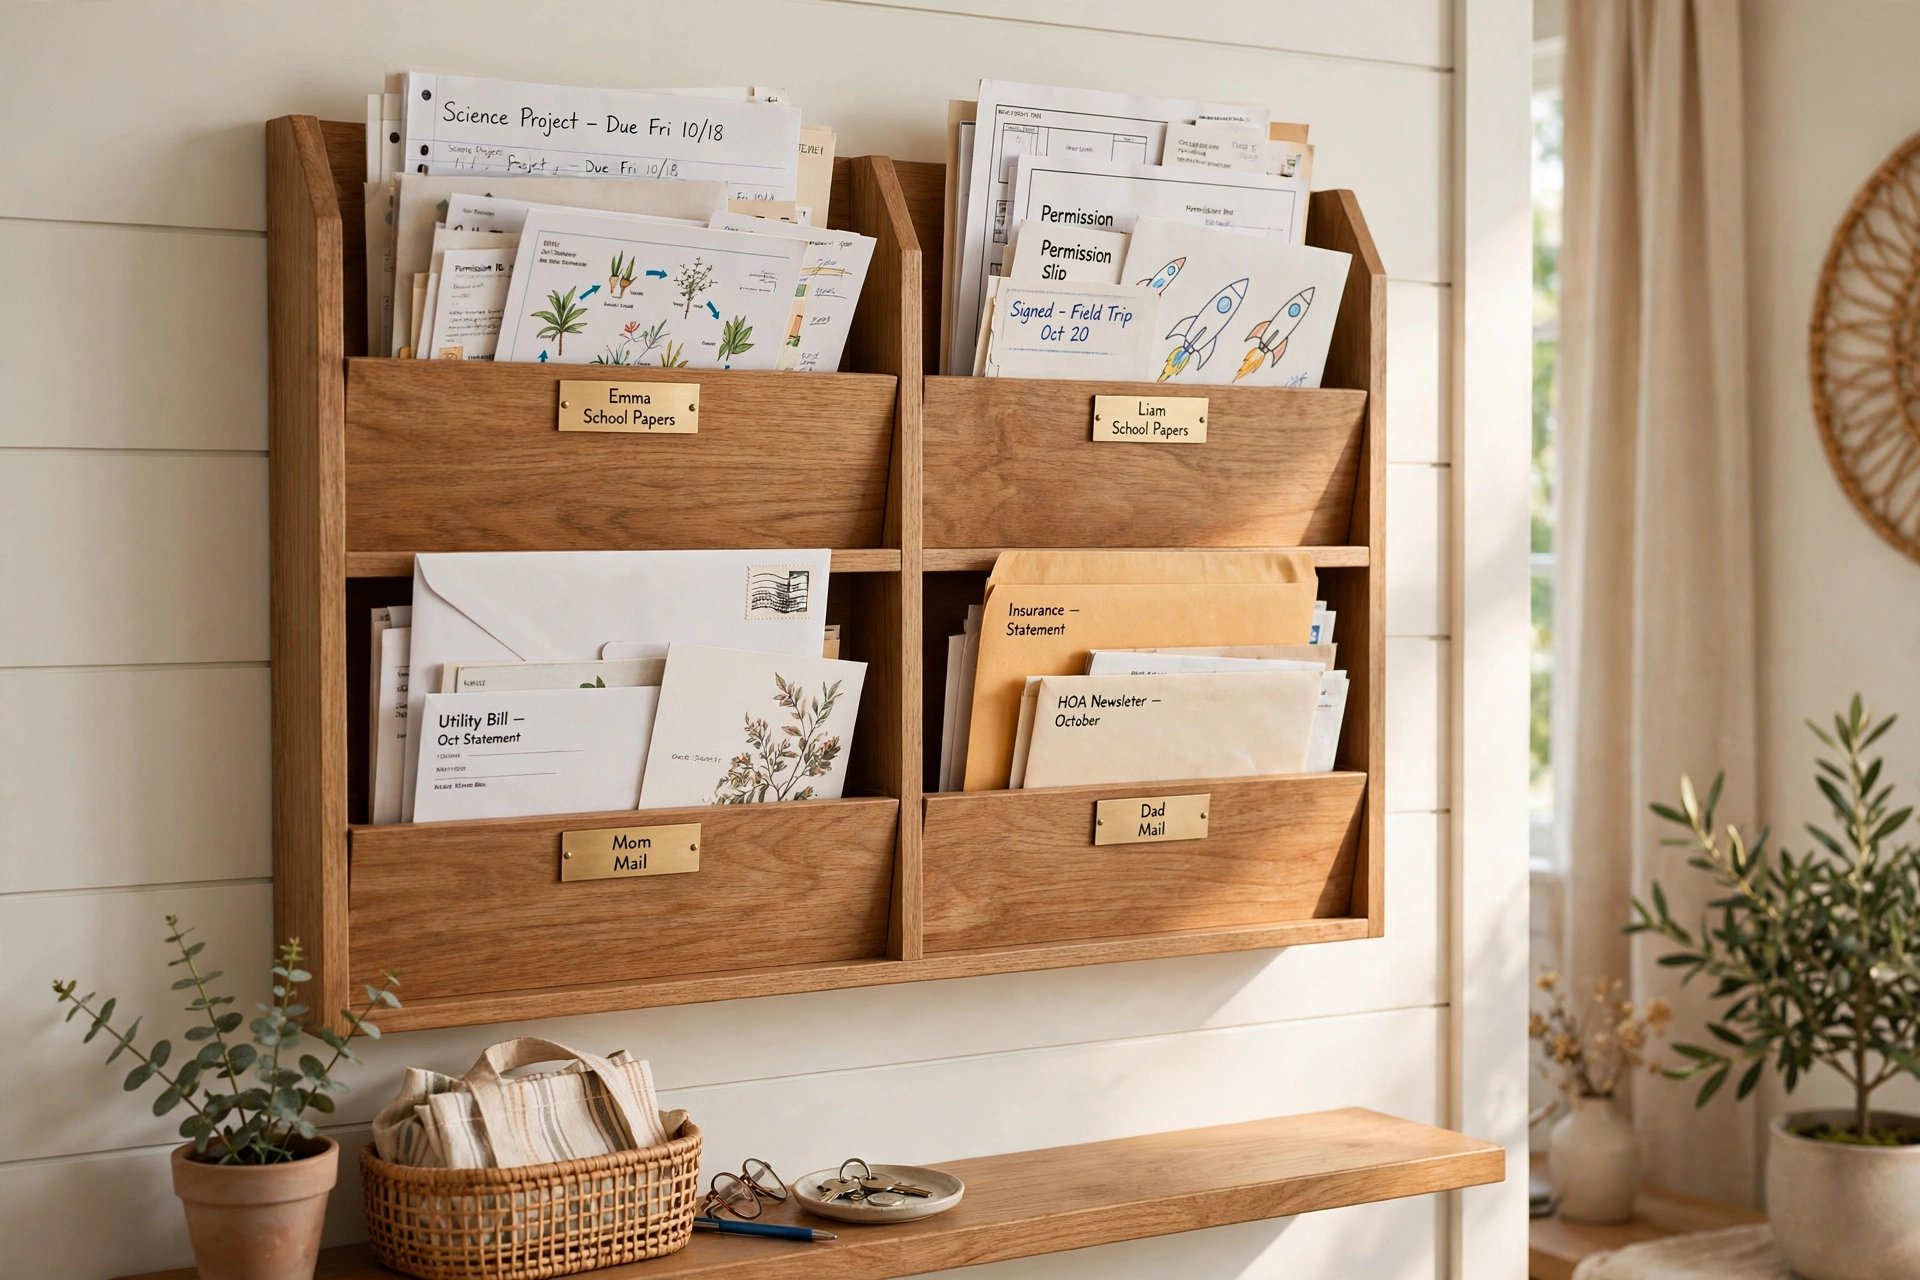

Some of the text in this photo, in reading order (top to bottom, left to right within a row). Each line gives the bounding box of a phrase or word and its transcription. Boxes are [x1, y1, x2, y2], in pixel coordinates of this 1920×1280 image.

[443, 100, 509, 126] Science
[520, 106, 579, 138] Project
[606, 114, 638, 135] Due
[649, 117, 672, 137] Fri
[682, 118, 724, 144] 10/18
[585, 159, 610, 175] Due
[620, 159, 637, 176] Fri
[646, 157, 679, 179] 10/18
[1041, 204, 1114, 227] Permission
[1040, 239, 1112, 264] Permission
[1010, 300, 1055, 325] Signed
[1070, 303, 1104, 321] Field
[1107, 305, 1133, 329] Trip
[1040, 324, 1090, 342] Oct 20
[609, 387, 651, 405] Emma
[1138, 400, 1166, 416] Liam
[582, 407, 676, 430] School Papers
[1112, 420, 1189, 440] School Papers
[1008, 602, 1065, 617] Insurance
[1005, 621, 1066, 637] Statement
[1057, 695, 1087, 709] HOA
[438, 713, 483, 732] Utility
[486, 711, 509, 727] Bill
[1054, 713, 1101, 728] October
[437, 732, 522, 747] Oct Statement
[1140, 801, 1166, 819] Dad
[1137, 820, 1166, 837] Mail
[611, 834, 652, 851] Mom
[613, 853, 647, 872] Mail
